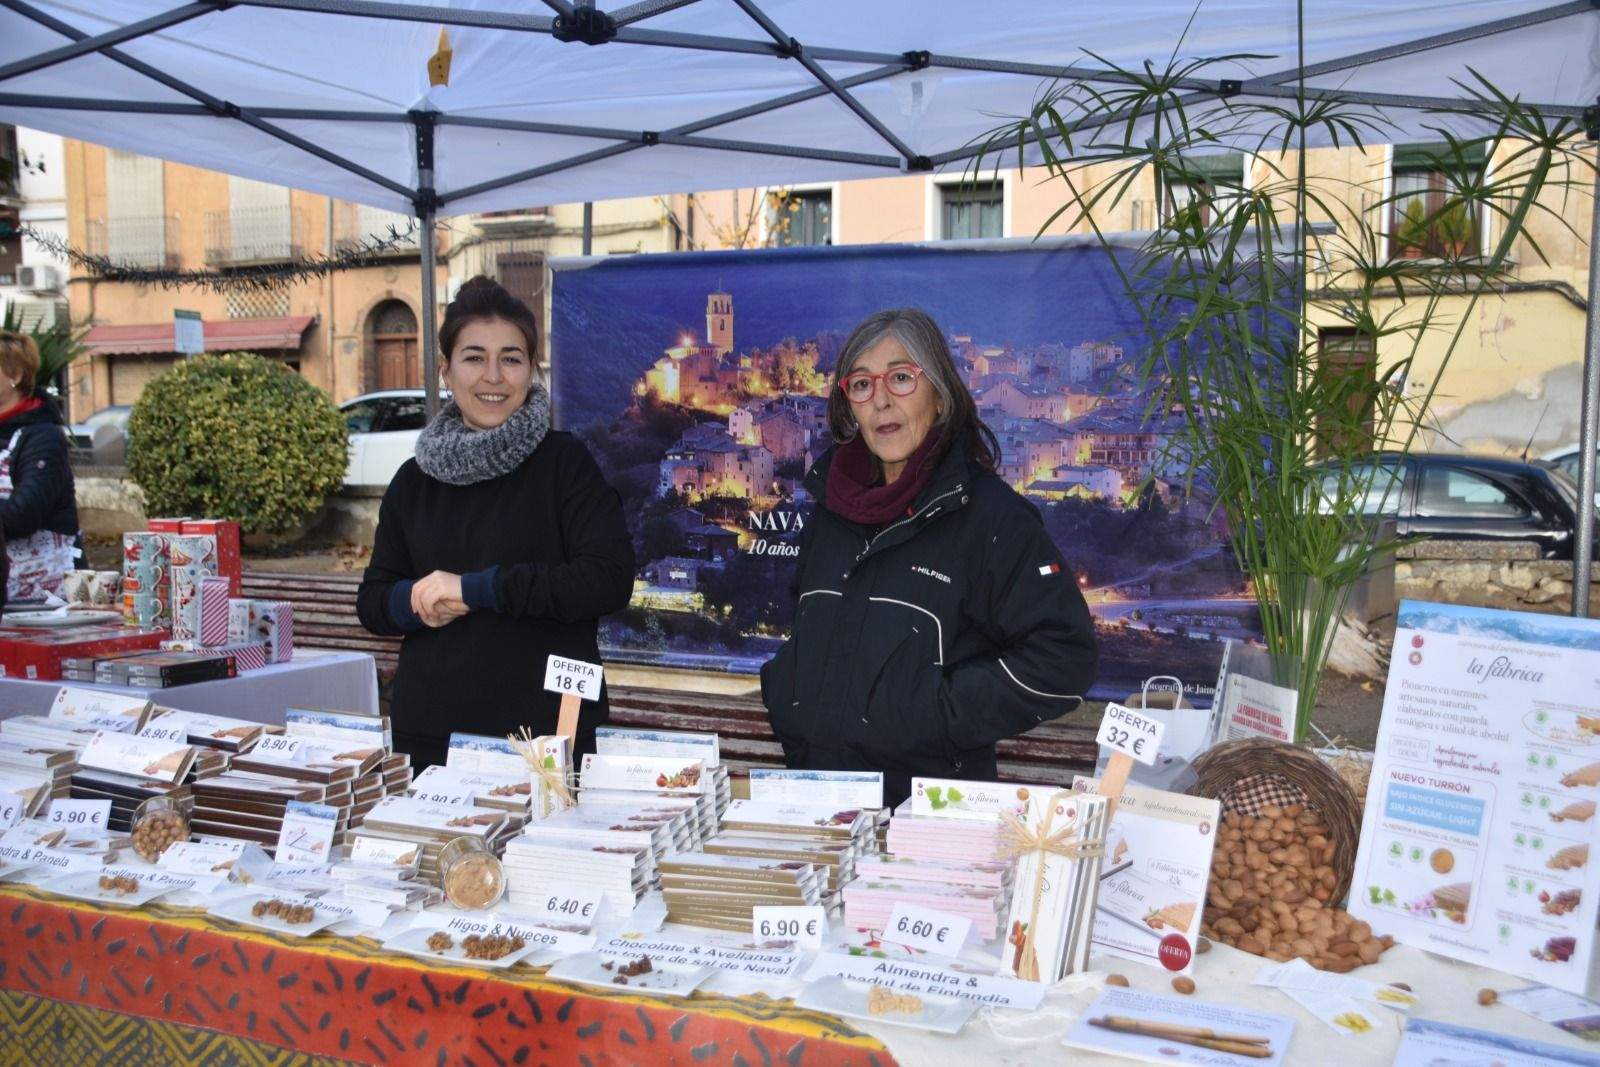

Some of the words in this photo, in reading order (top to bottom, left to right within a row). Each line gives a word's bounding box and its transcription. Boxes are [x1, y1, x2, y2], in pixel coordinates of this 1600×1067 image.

[747, 539, 767, 555] 10
[767, 541, 800, 557] años
[917, 566, 952, 584] HILFIGER
[553, 659, 595, 678] OFERTA
[1466, 657, 1484, 674] la
[1477, 655, 1544, 684] fábrica
[555, 675, 572, 689] 18
[576, 680, 586, 693] €
[1184, 683, 1195, 693] de
[1195, 683, 1216, 695] Jaim
[1438, 686, 1450, 695] en
[1109, 707, 1156, 735] OFERTA
[1442, 711, 1458, 721] con
[141, 729, 168, 739] 8.90
[169, 730, 179, 740] €
[1467, 725, 1478, 736] de
[289, 741, 298, 751] €
[1107, 726, 1129, 748] 32
[1133, 738, 1145, 755] €
[1390, 771, 1425, 784] NUEVO
[1428, 778, 1471, 793] TURRÓN
[4, 807, 13, 819] €
[53, 810, 87, 823] 3.90
[91, 811, 101, 823] €
[21, 849, 31, 859] &
[32, 850, 70, 867] Panela
[547, 896, 579, 914] 6.40
[582, 902, 593, 916] €
[448, 917, 488, 933] Higos
[491, 924, 502, 935] &
[506, 925, 559, 945] Nueces
[760, 919, 800, 936] 6.90
[806, 919, 817, 936] €
[897, 916, 932, 938] 6.60
[936, 927, 949, 943] €
[609, 938, 685, 952] Chocolate
[688, 946, 701, 955] &
[704, 948, 782, 964] Avellanas
[785, 954, 798, 964] y
[1160, 944, 1189, 959] OFERTA
[668, 954, 689, 964] de
[693, 957, 715, 968] sal
[719, 959, 740, 970] de
[743, 962, 792, 976] Naval
[874, 962, 961, 986] Almendra
[965, 976, 979, 987] &
[900, 982, 921, 991] de
[926, 985, 1011, 1005] Finlandia
